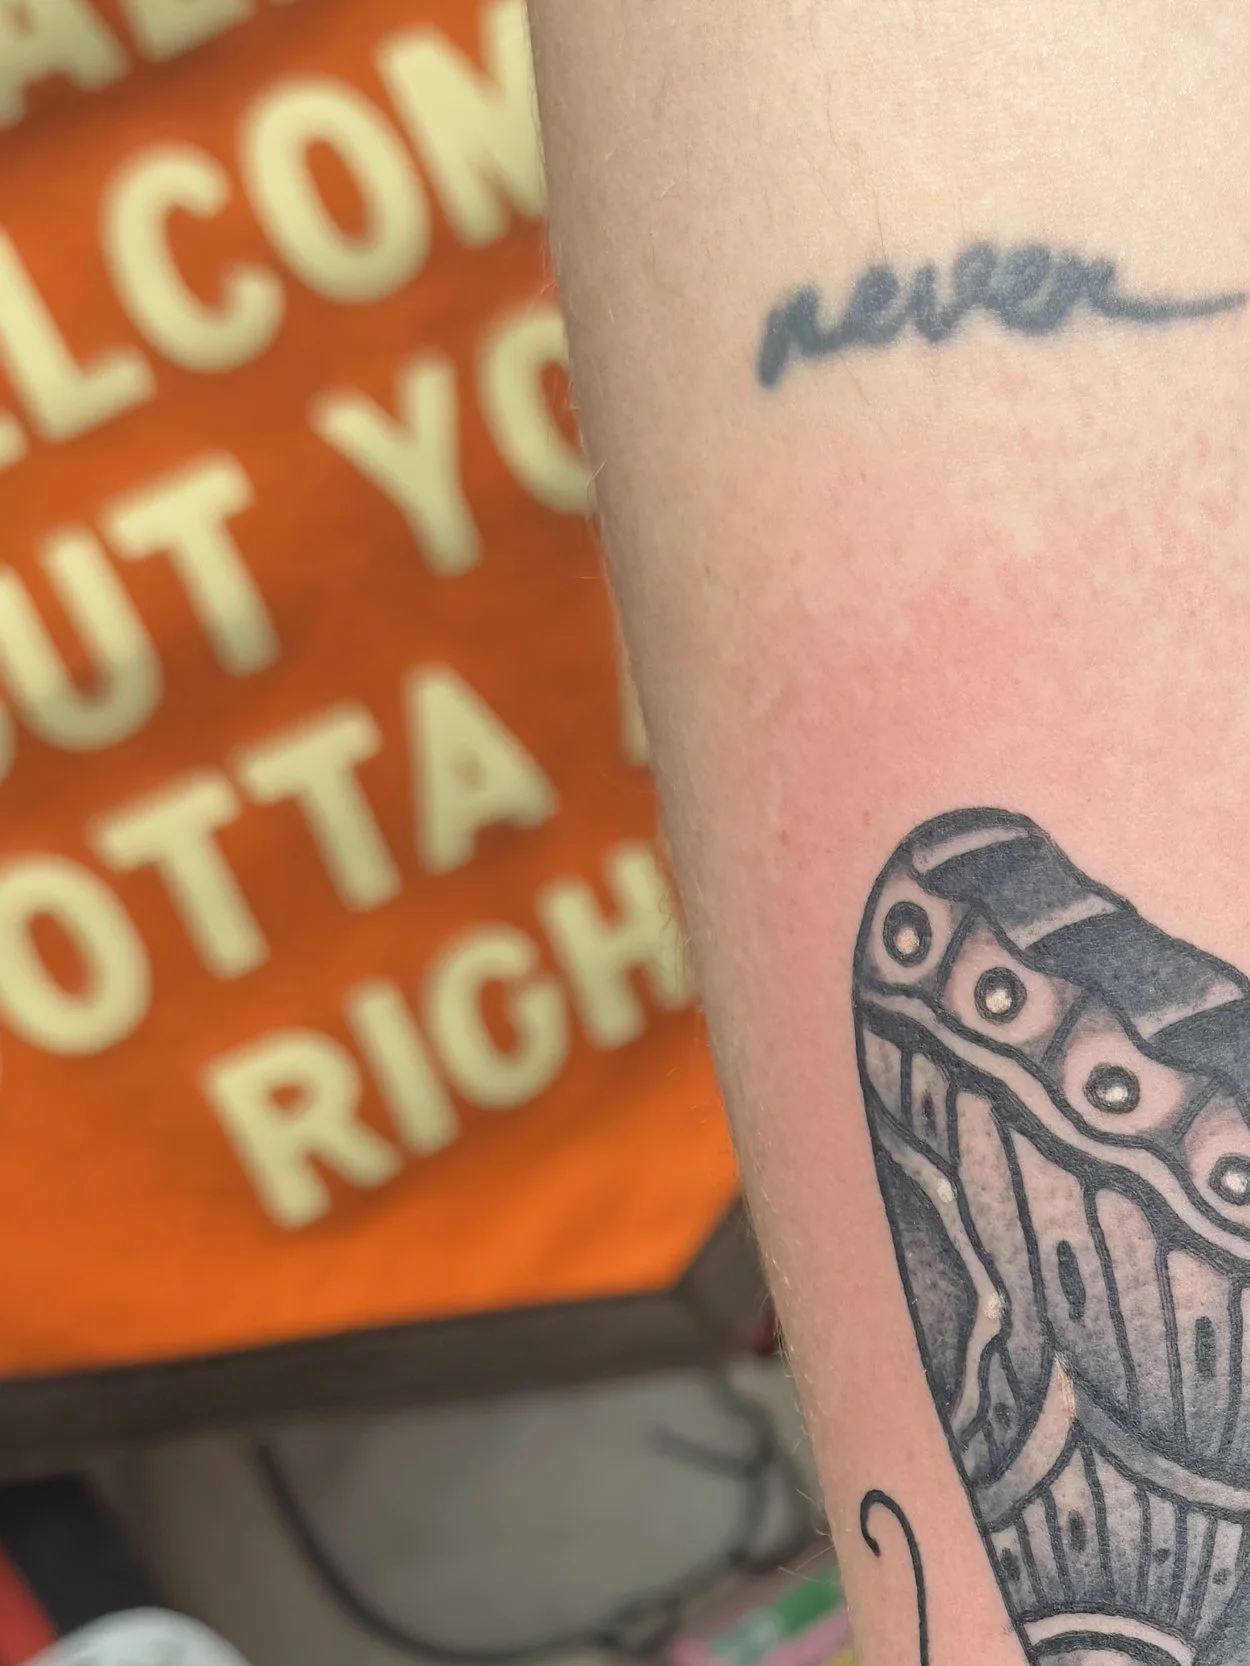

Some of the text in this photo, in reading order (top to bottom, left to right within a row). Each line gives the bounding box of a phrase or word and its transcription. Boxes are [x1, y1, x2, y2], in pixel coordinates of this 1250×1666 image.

[0, 0, 548, 470] LCOM
[758, 240, 1247, 388] never
[0, 450, 280, 782] UT
